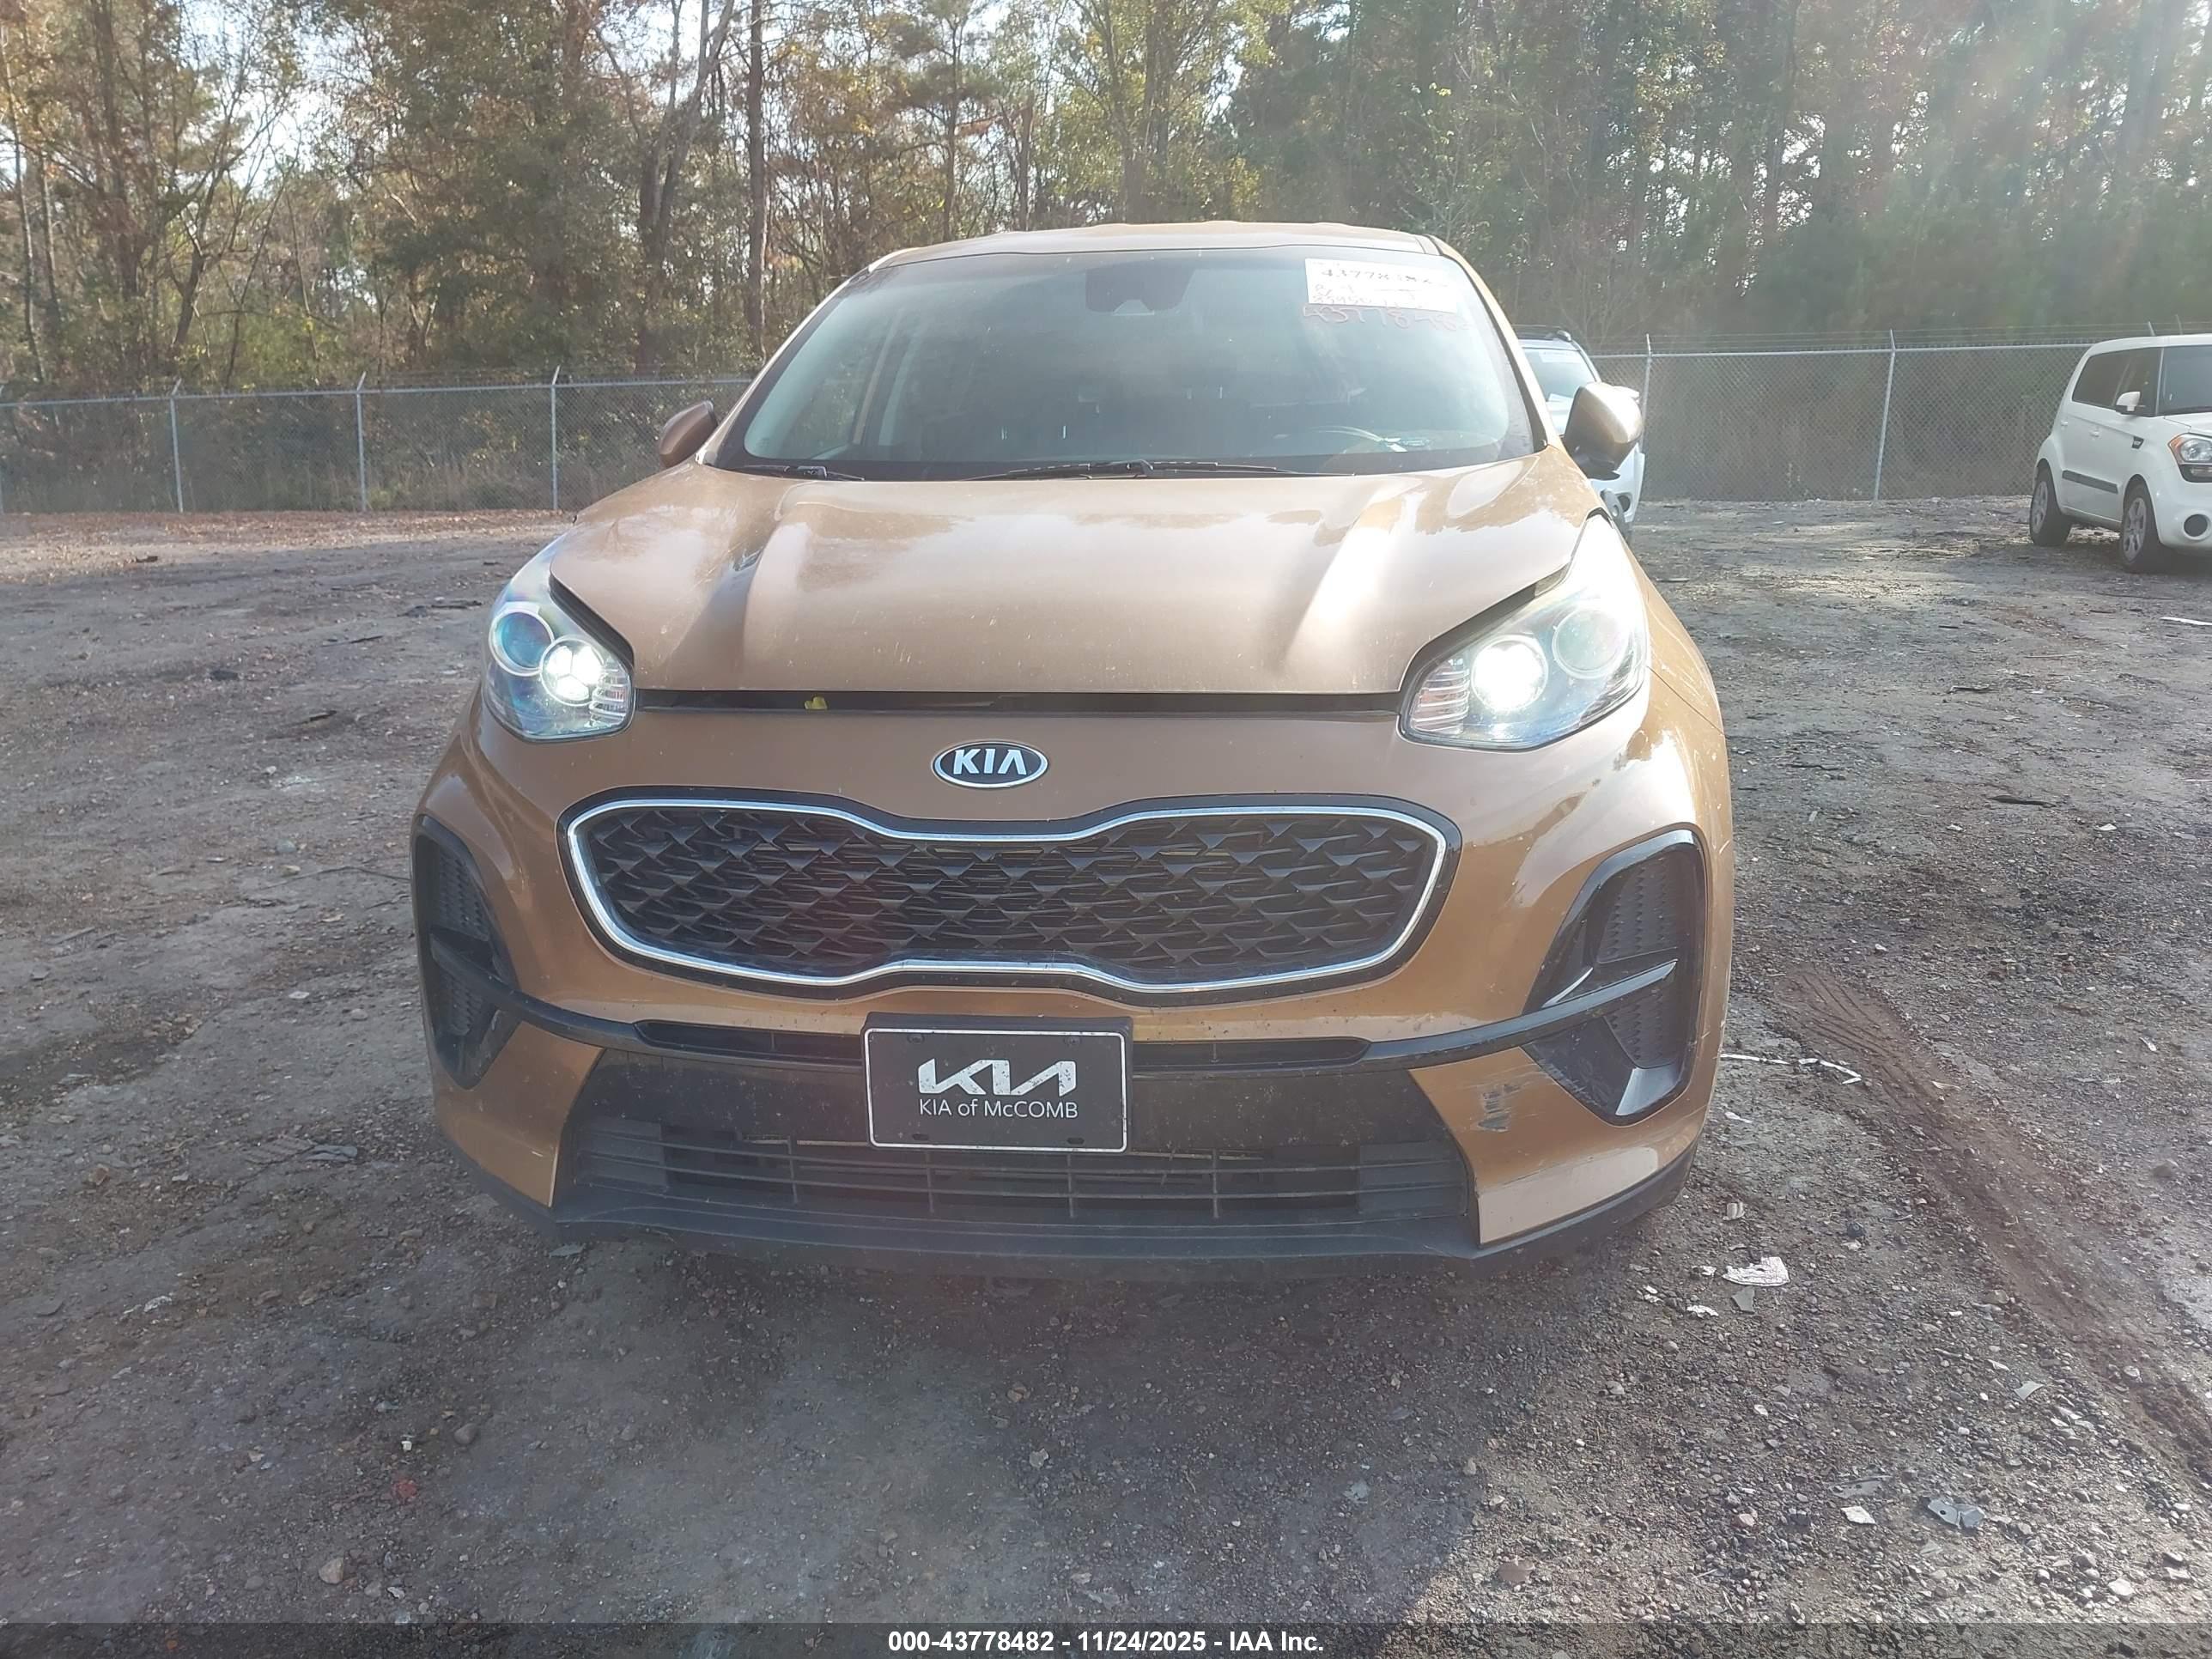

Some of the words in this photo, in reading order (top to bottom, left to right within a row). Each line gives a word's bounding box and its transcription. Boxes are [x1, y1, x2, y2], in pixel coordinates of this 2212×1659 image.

[953, 748, 1027, 775] KIA
[917, 1058, 1077, 1097] KIA
[920, 1098, 952, 1116] KIA
[957, 1099, 978, 1117] of
[984, 1100, 1079, 1119] McCOMB
